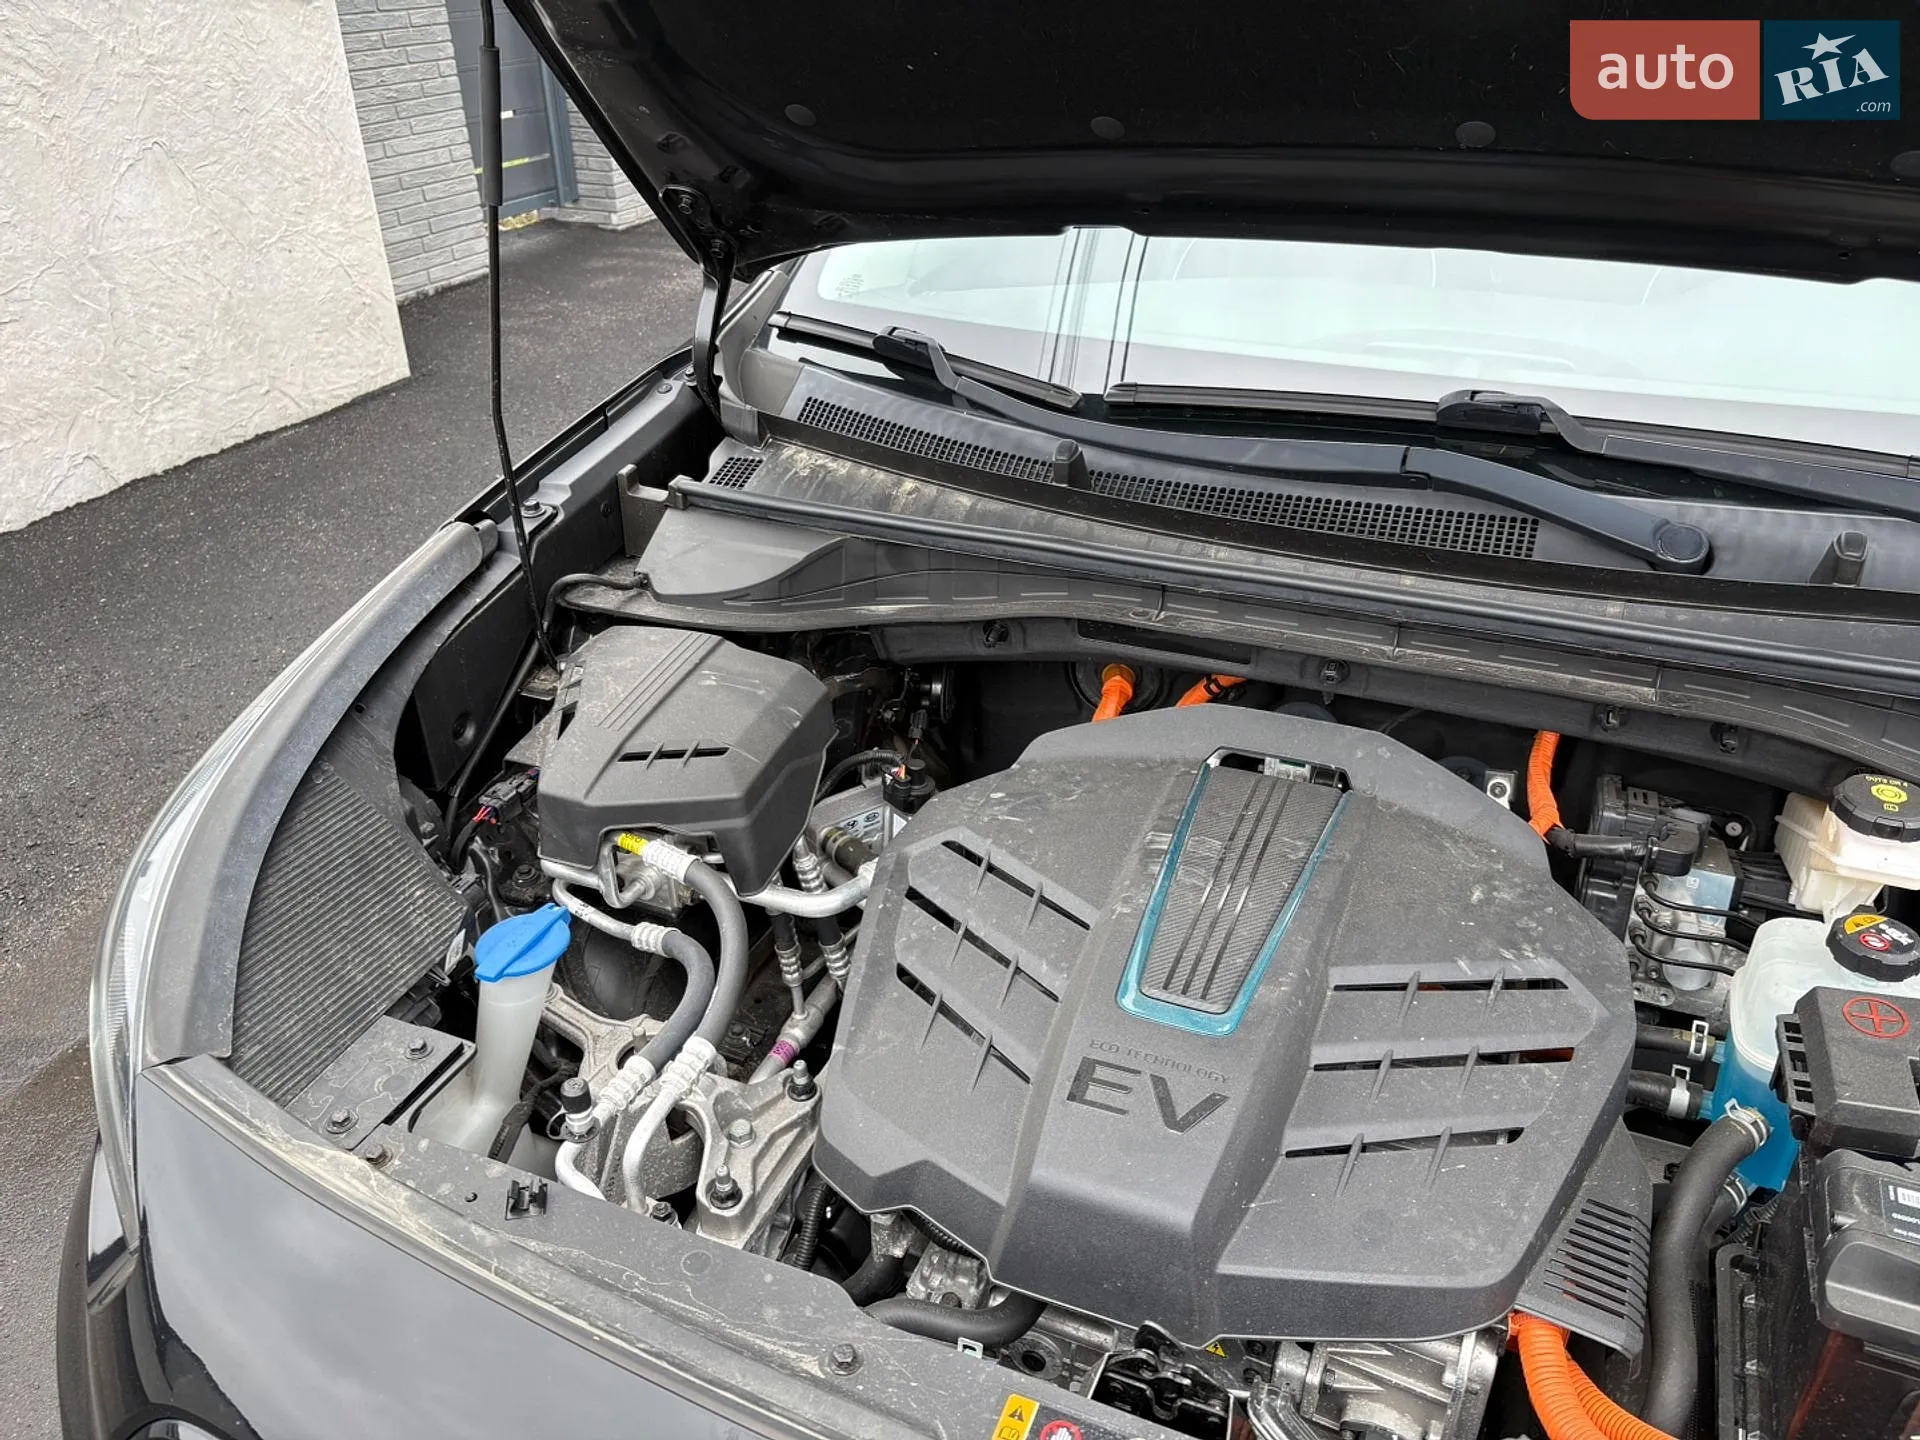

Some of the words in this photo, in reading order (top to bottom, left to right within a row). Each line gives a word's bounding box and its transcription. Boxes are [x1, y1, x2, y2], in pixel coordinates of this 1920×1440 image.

[1089, 1039, 1121, 1054] ECO
[1126, 1047, 1231, 1083] TECHNOLOGY
[1066, 1056, 1230, 1134] EV
